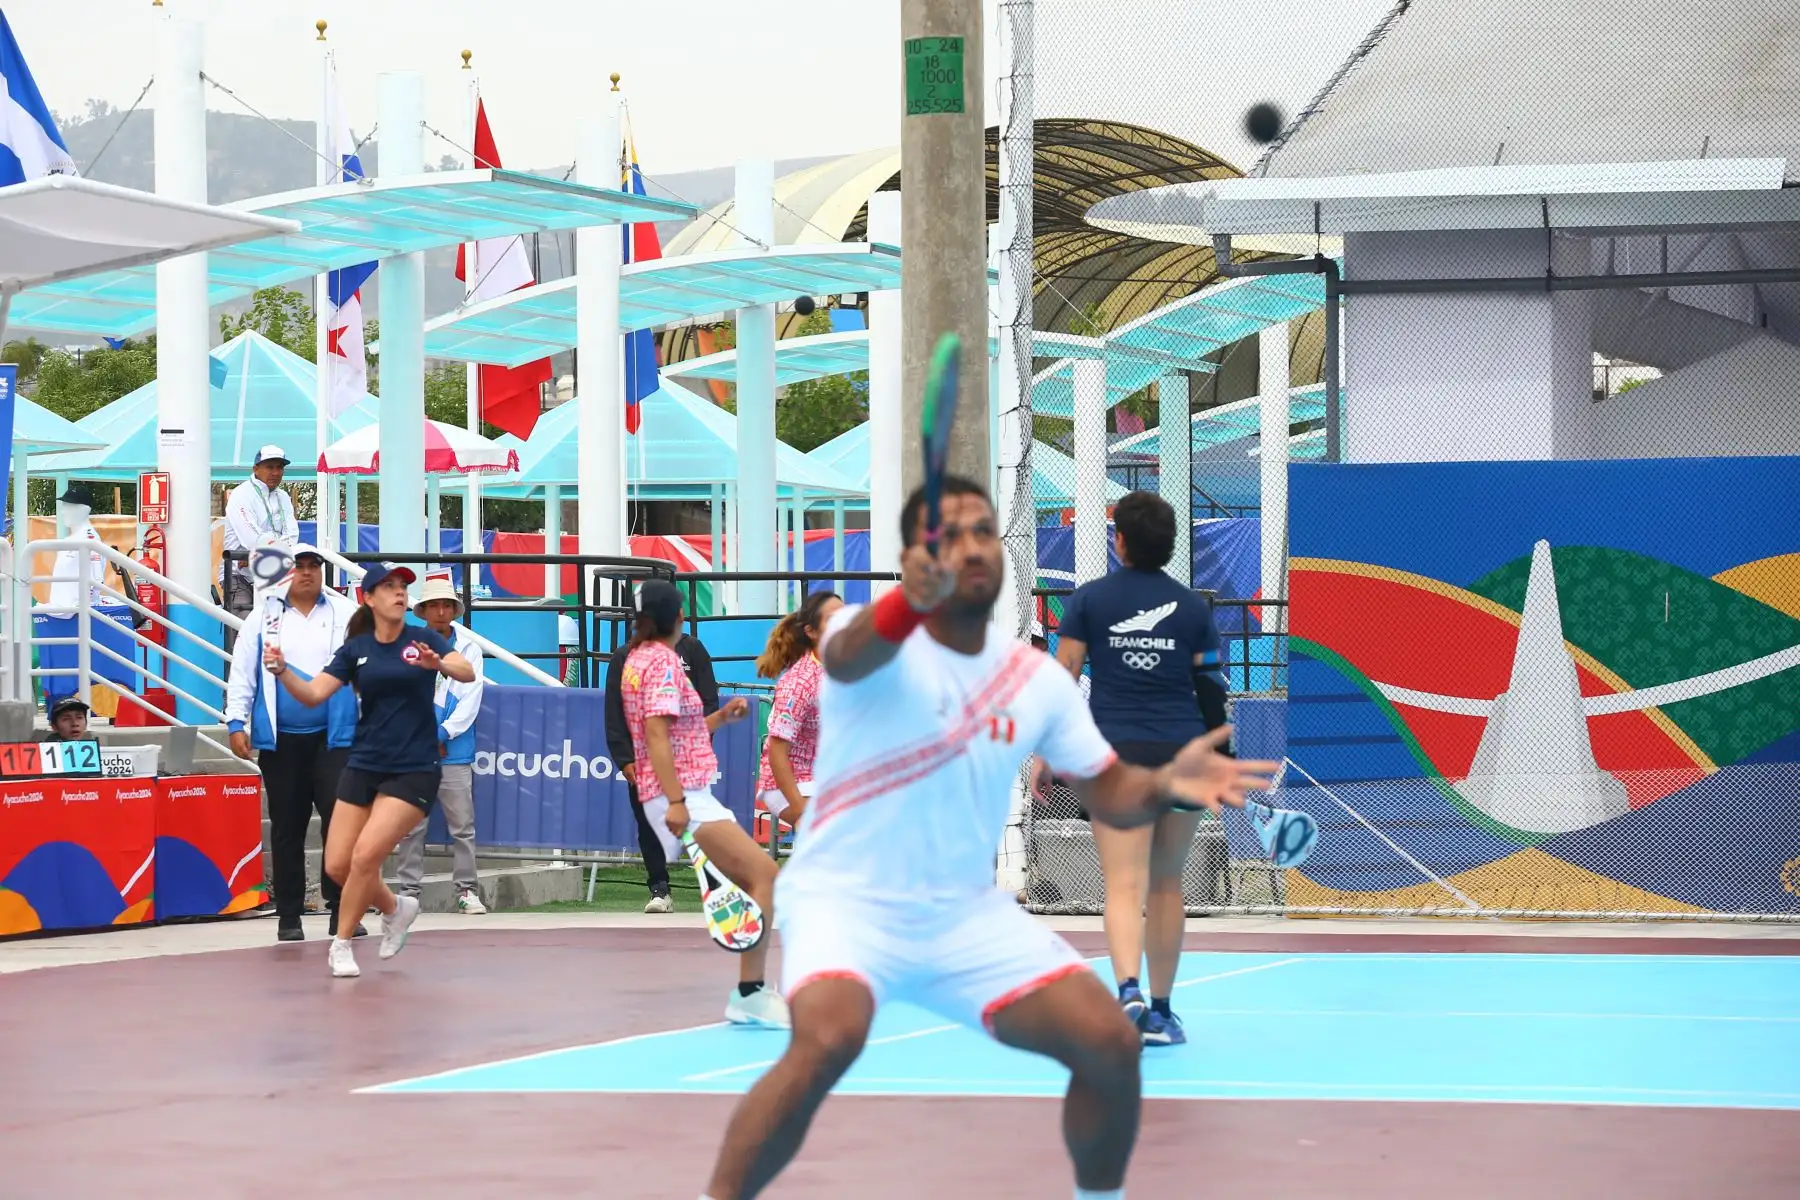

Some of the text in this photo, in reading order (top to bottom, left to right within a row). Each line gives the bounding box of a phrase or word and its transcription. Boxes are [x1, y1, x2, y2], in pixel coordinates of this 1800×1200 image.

[921, 69, 956, 84] 1000
[927, 85, 936, 99] 2
[101, 754, 132, 766] ucho
[107, 766, 132, 775] 2024
